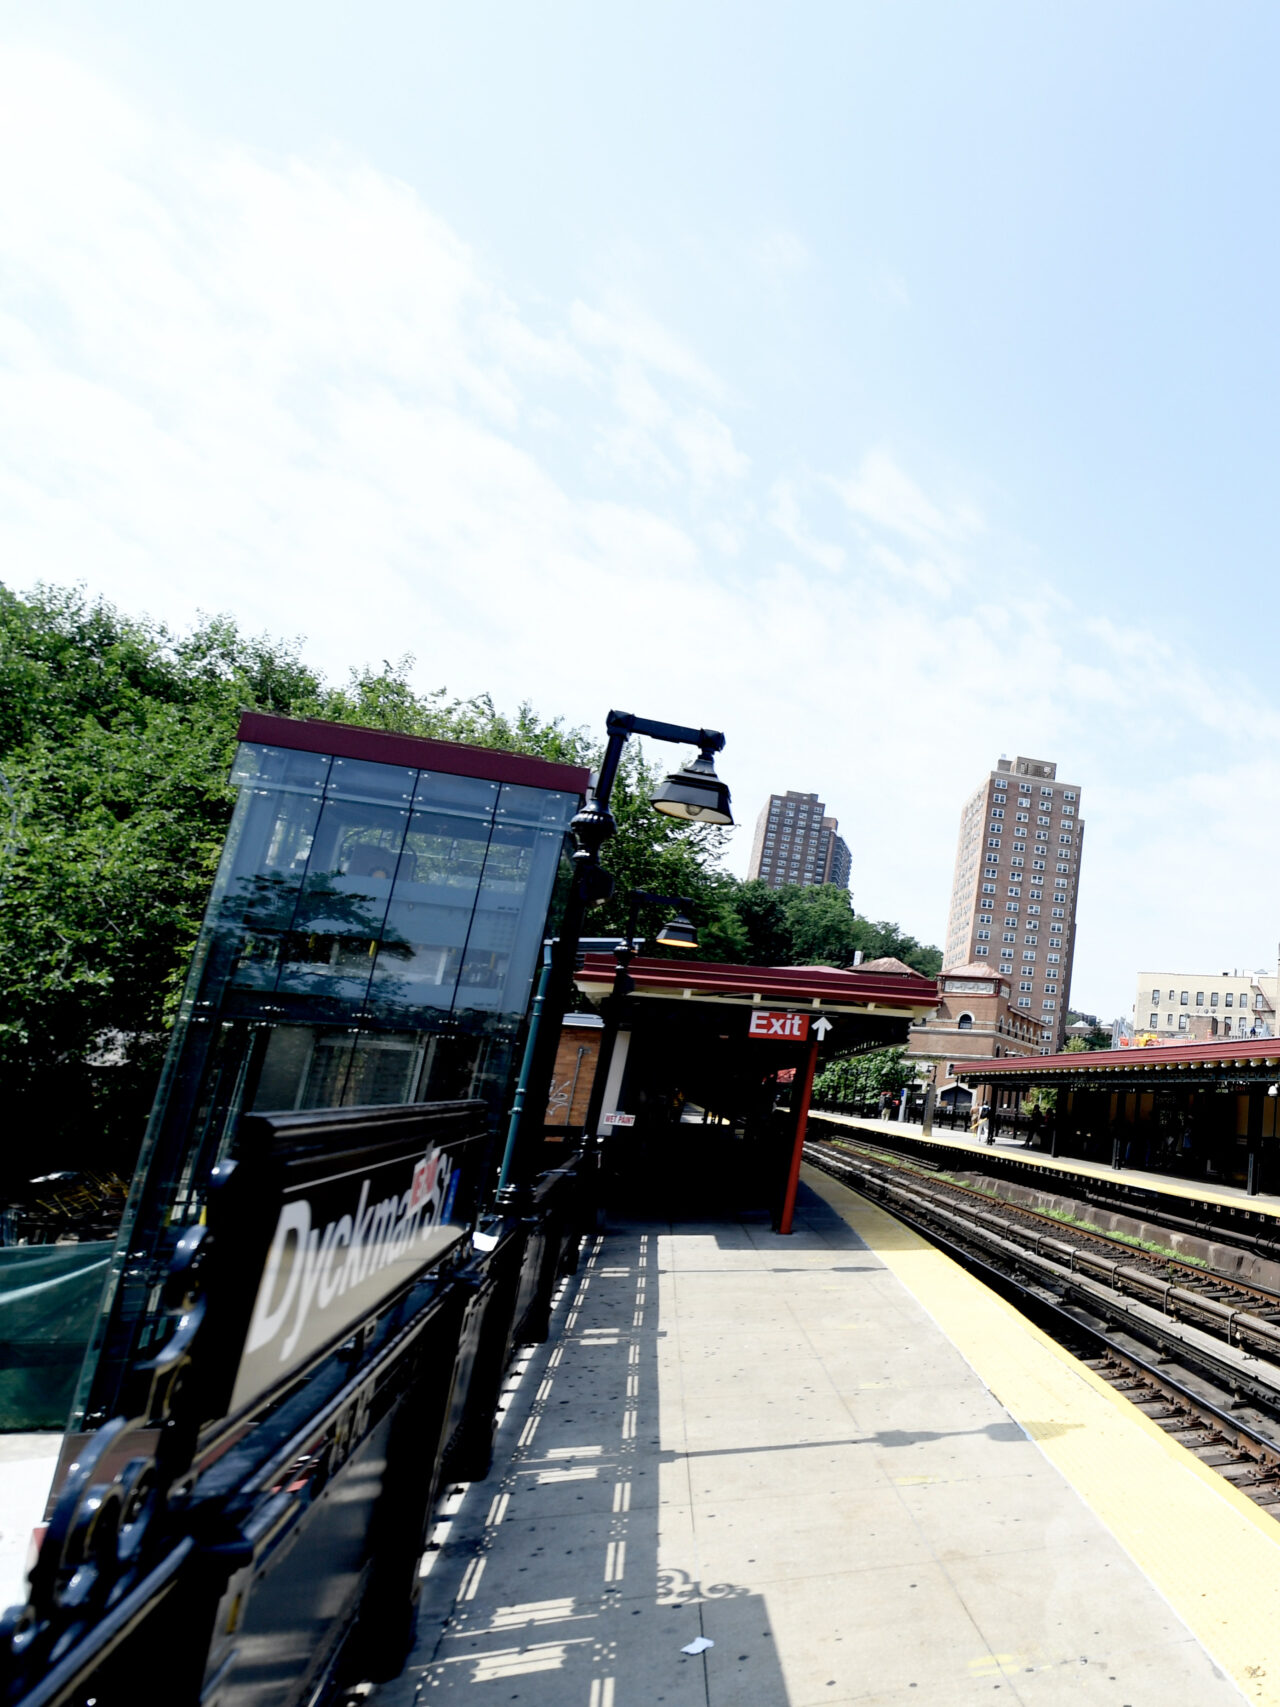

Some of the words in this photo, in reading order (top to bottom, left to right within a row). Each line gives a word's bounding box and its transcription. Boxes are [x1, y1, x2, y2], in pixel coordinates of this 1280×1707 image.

[749, 1011, 803, 1036] Exit
[605, 1115, 617, 1123] WET
[618, 1115, 635, 1124] PAINT
[246, 1179, 421, 1361] Dyckman
[422, 1153, 453, 1240] St
